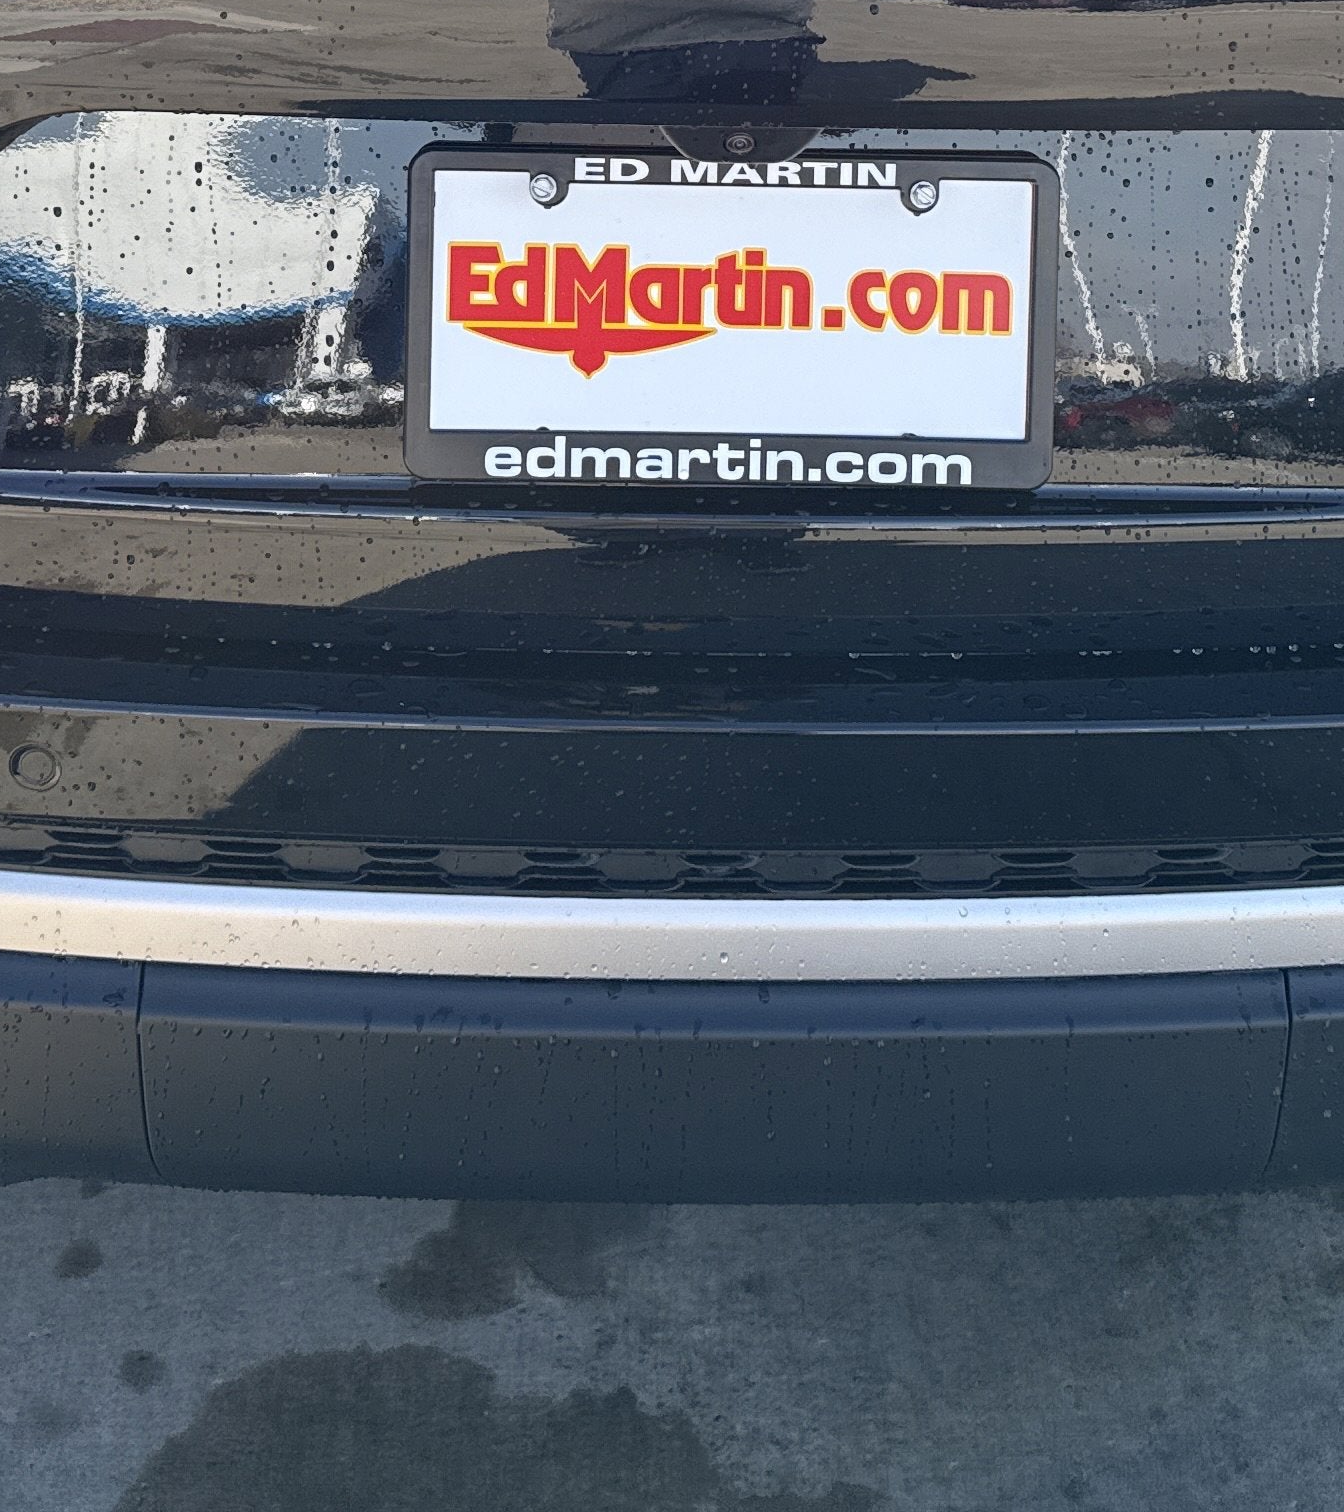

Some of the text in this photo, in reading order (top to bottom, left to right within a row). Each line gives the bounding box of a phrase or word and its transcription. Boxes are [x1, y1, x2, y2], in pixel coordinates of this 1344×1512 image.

[574, 156, 897, 187] ED MARTIN
[447, 241, 1014, 337] EdMartin.com
[483, 435, 973, 486] edmartin.com
